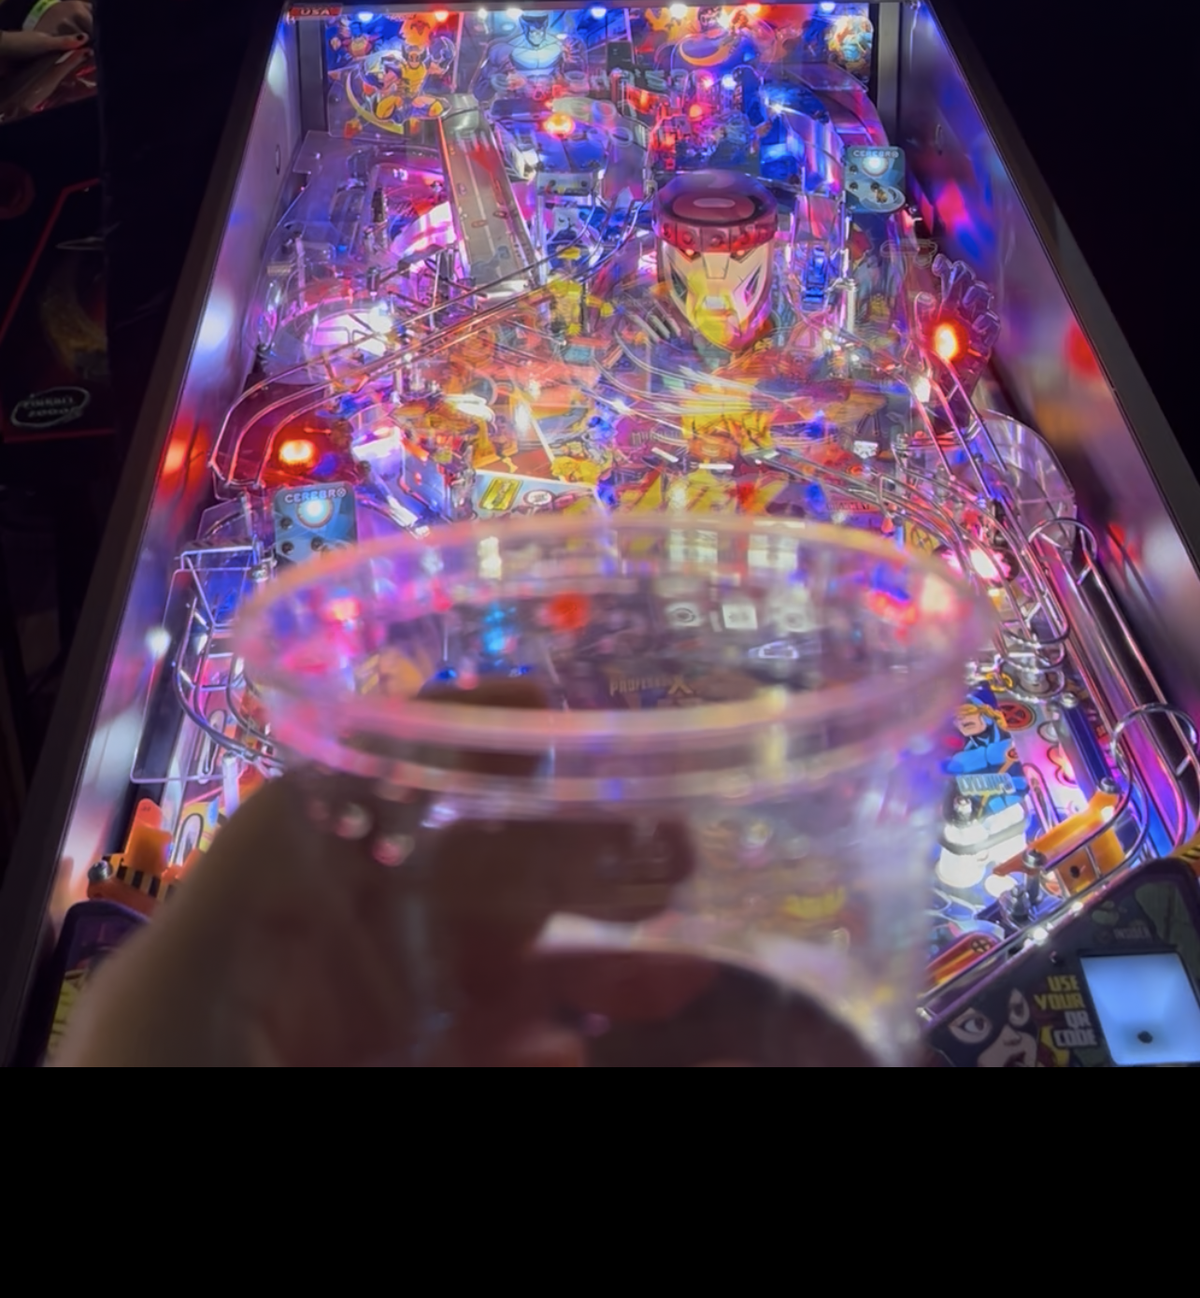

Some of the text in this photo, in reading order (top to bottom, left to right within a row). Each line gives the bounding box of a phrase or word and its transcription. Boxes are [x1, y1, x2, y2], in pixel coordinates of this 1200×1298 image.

[300, 7, 330, 16] USA
[284, 487, 347, 503] CEREBRO
[1047, 975, 1080, 991] USE
[1034, 992, 1086, 1010] YOUR
[1064, 1010, 1091, 1027] QR
[1053, 1028, 1097, 1047] CODE
